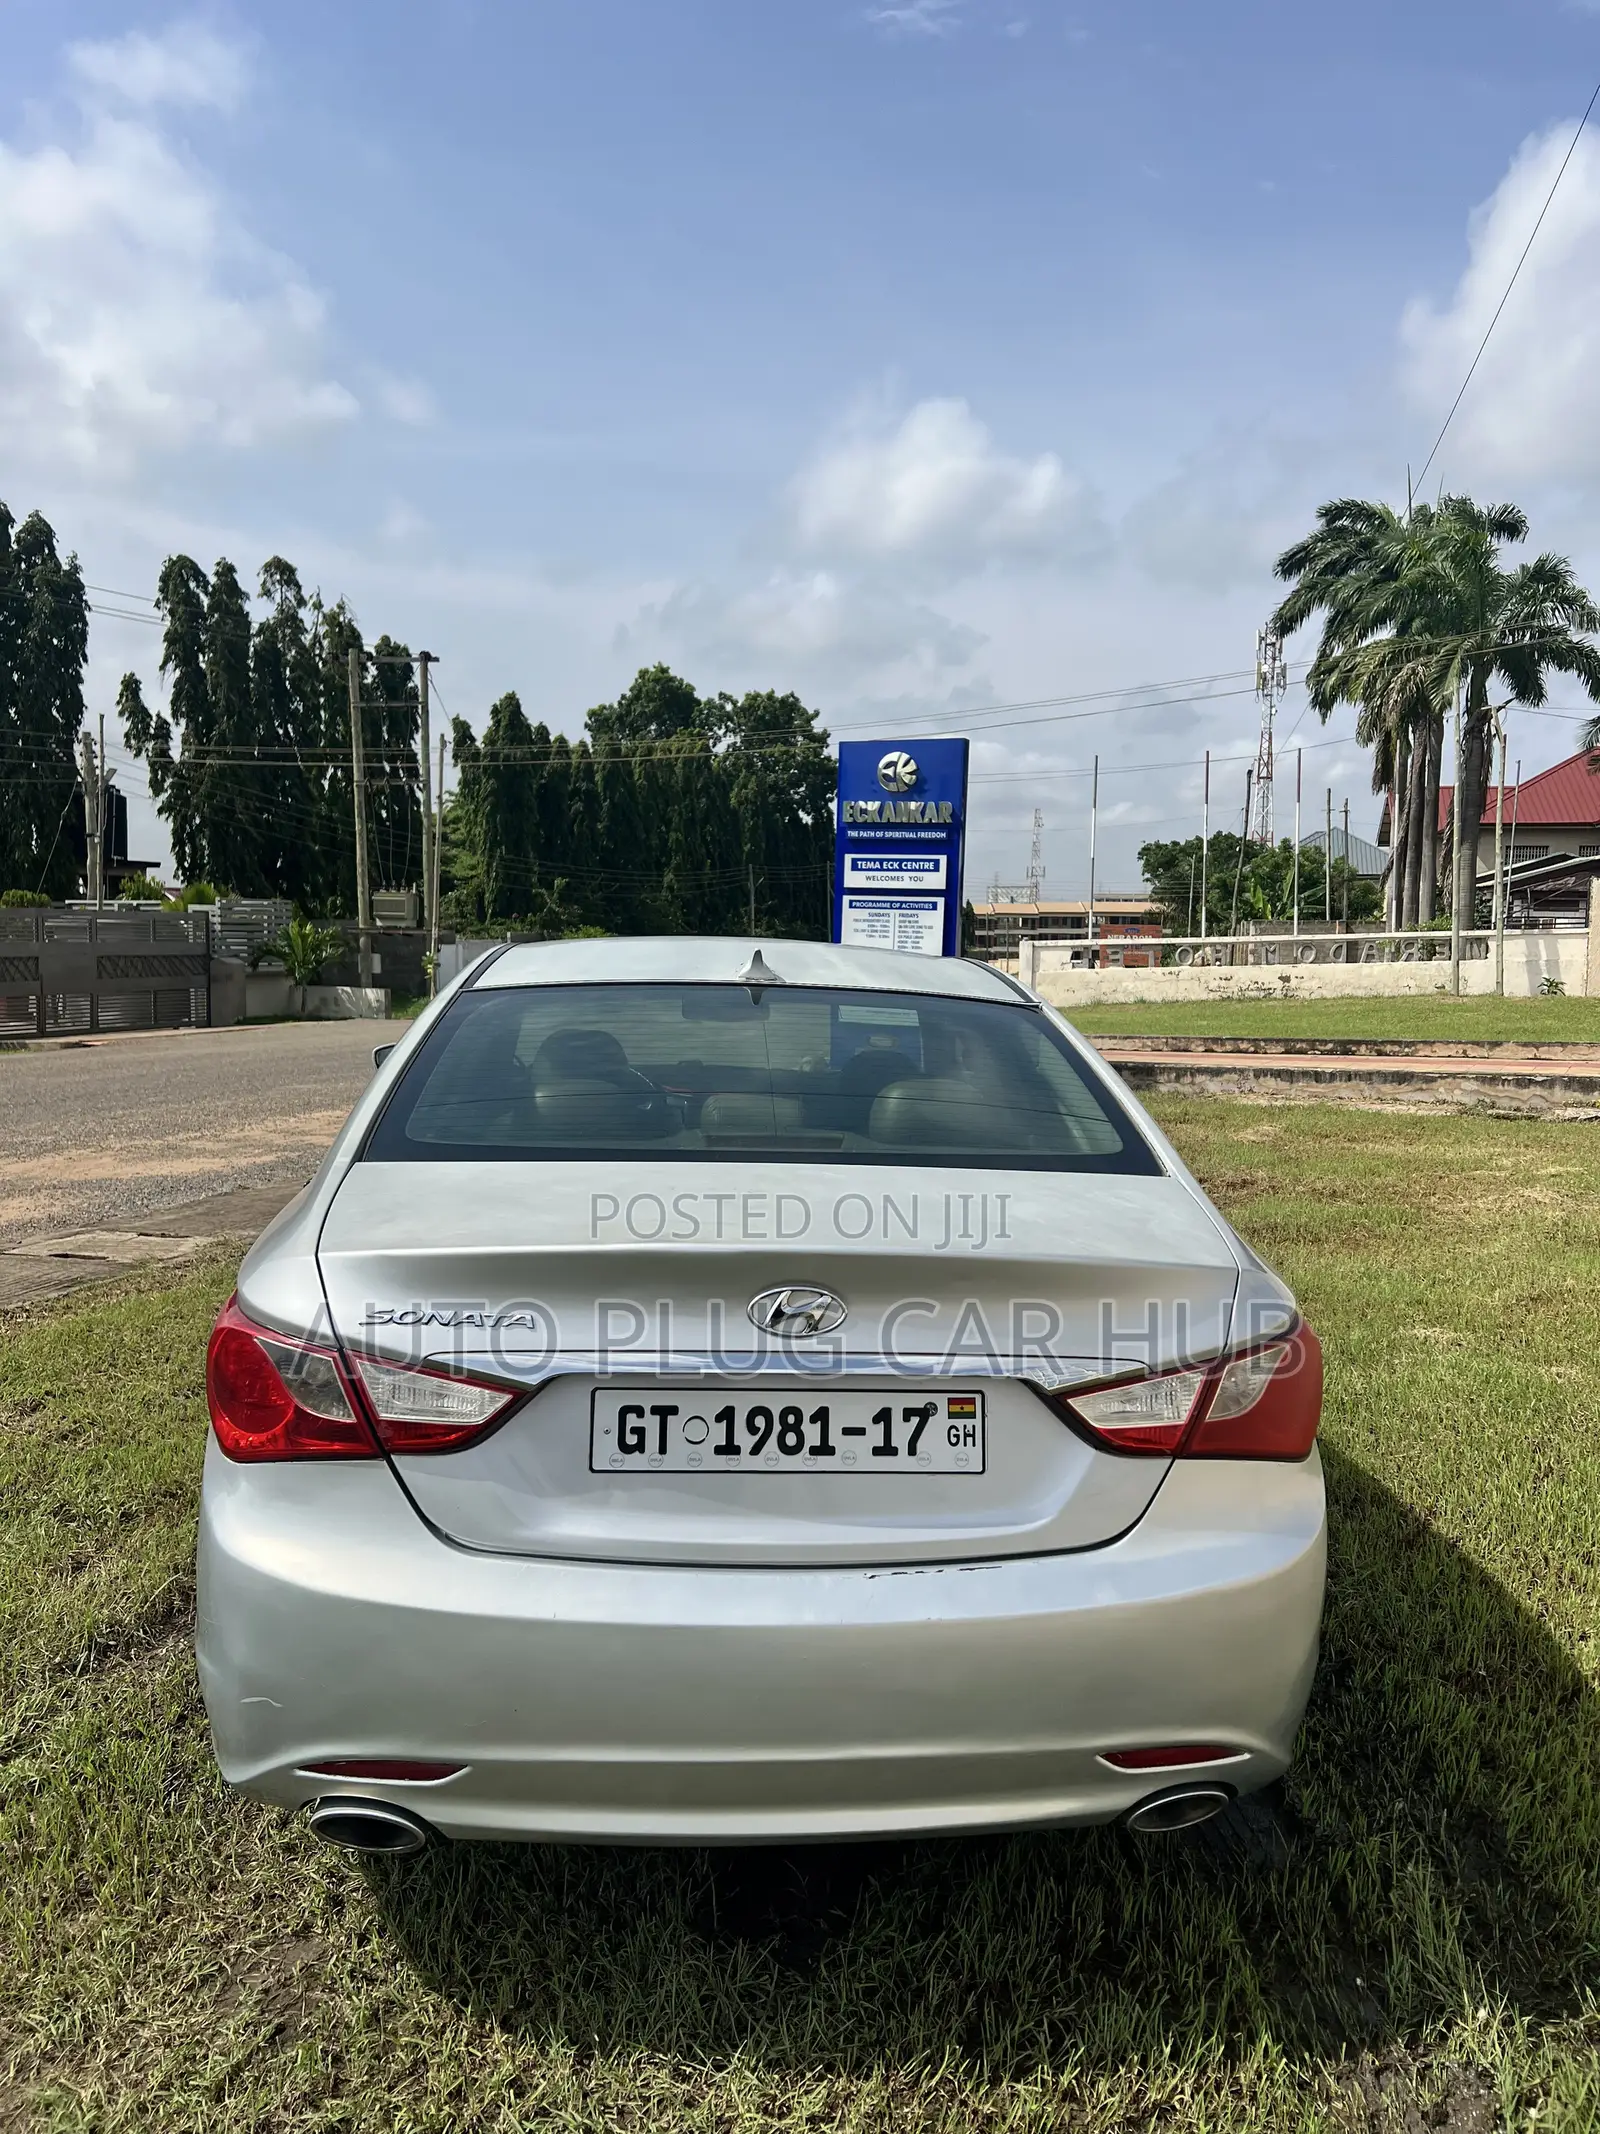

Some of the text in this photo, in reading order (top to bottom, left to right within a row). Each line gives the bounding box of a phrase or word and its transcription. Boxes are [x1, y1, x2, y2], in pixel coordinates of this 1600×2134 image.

[842, 800, 953, 824] ECKANKAR
[847, 830, 858, 838] THE
[860, 830, 875, 838] PATH
[918, 831, 946, 839] FREEDOM
[857, 861, 935, 870] TEMA ECK CENTRE
[358, 1308, 535, 1330] SONATA
[617, 1404, 932, 1457] GT 1981-17
[947, 1424, 976, 1448] GH
